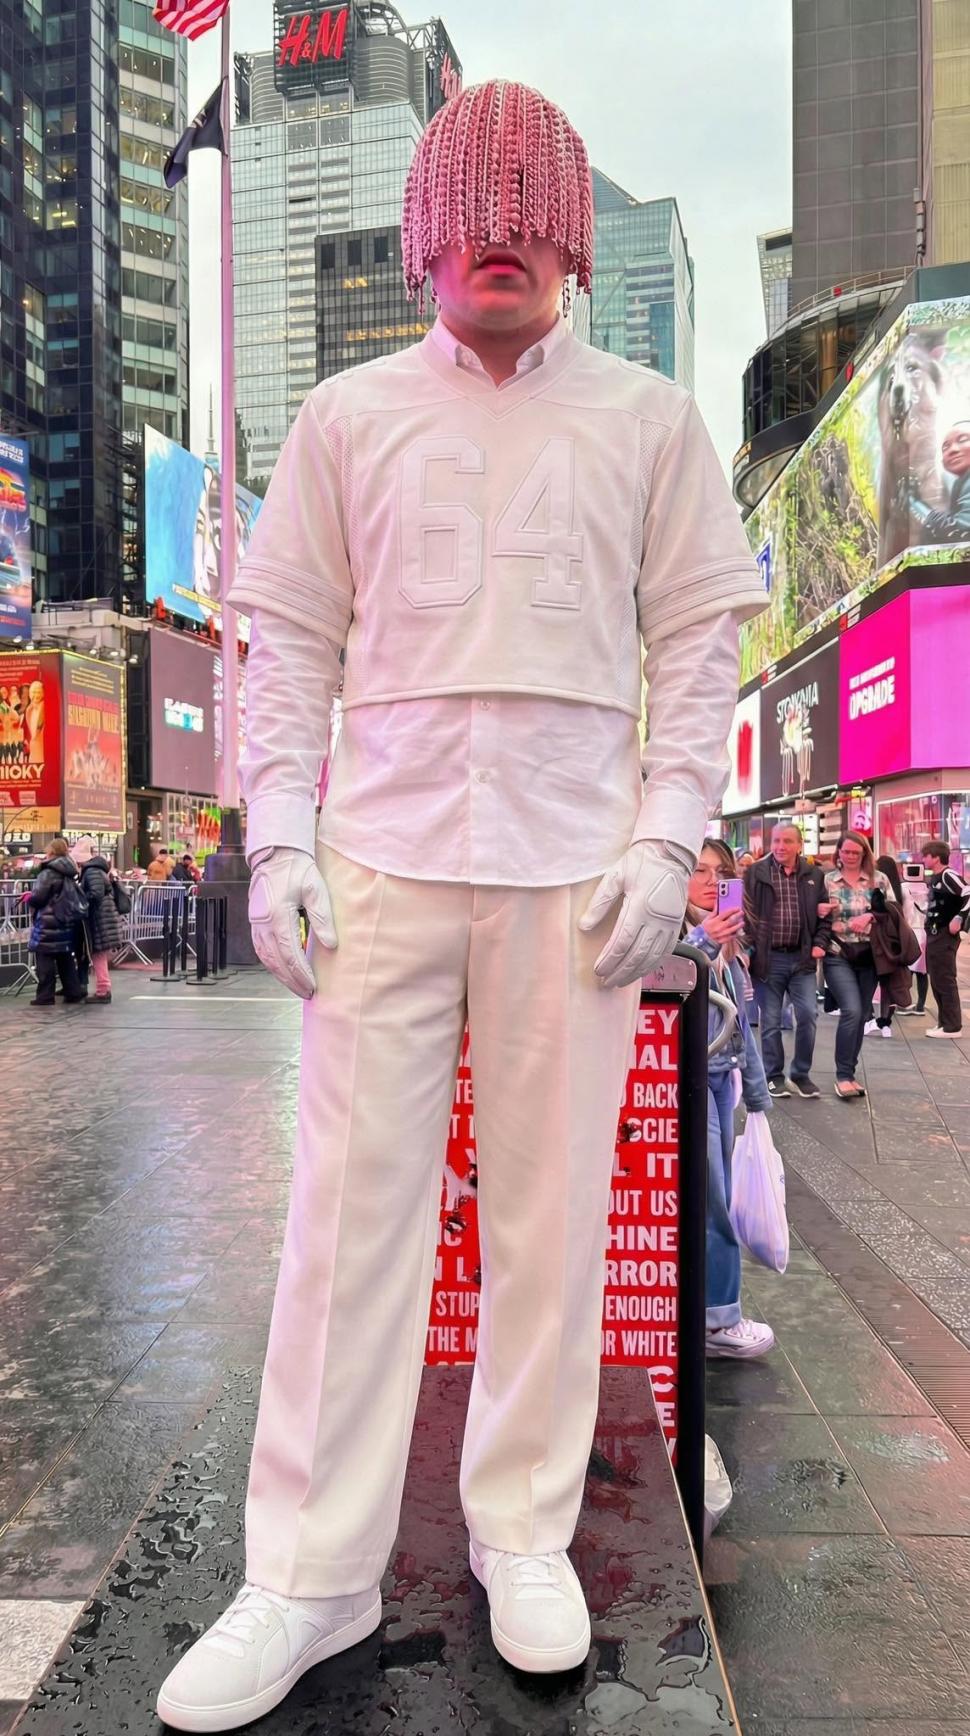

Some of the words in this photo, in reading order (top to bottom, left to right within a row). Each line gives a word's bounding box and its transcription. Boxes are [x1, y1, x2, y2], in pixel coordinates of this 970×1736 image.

[276, 8, 349, 67] H&M
[398, 434, 583, 611] 64
[633, 1083, 679, 1109] BACK
[646, 1152, 679, 1179] IT
[650, 1190, 678, 1217] US
[605, 1295, 677, 1322] ENOUGH
[428, 1326, 460, 1352] THE
[621, 1330, 678, 1357] WHITE
